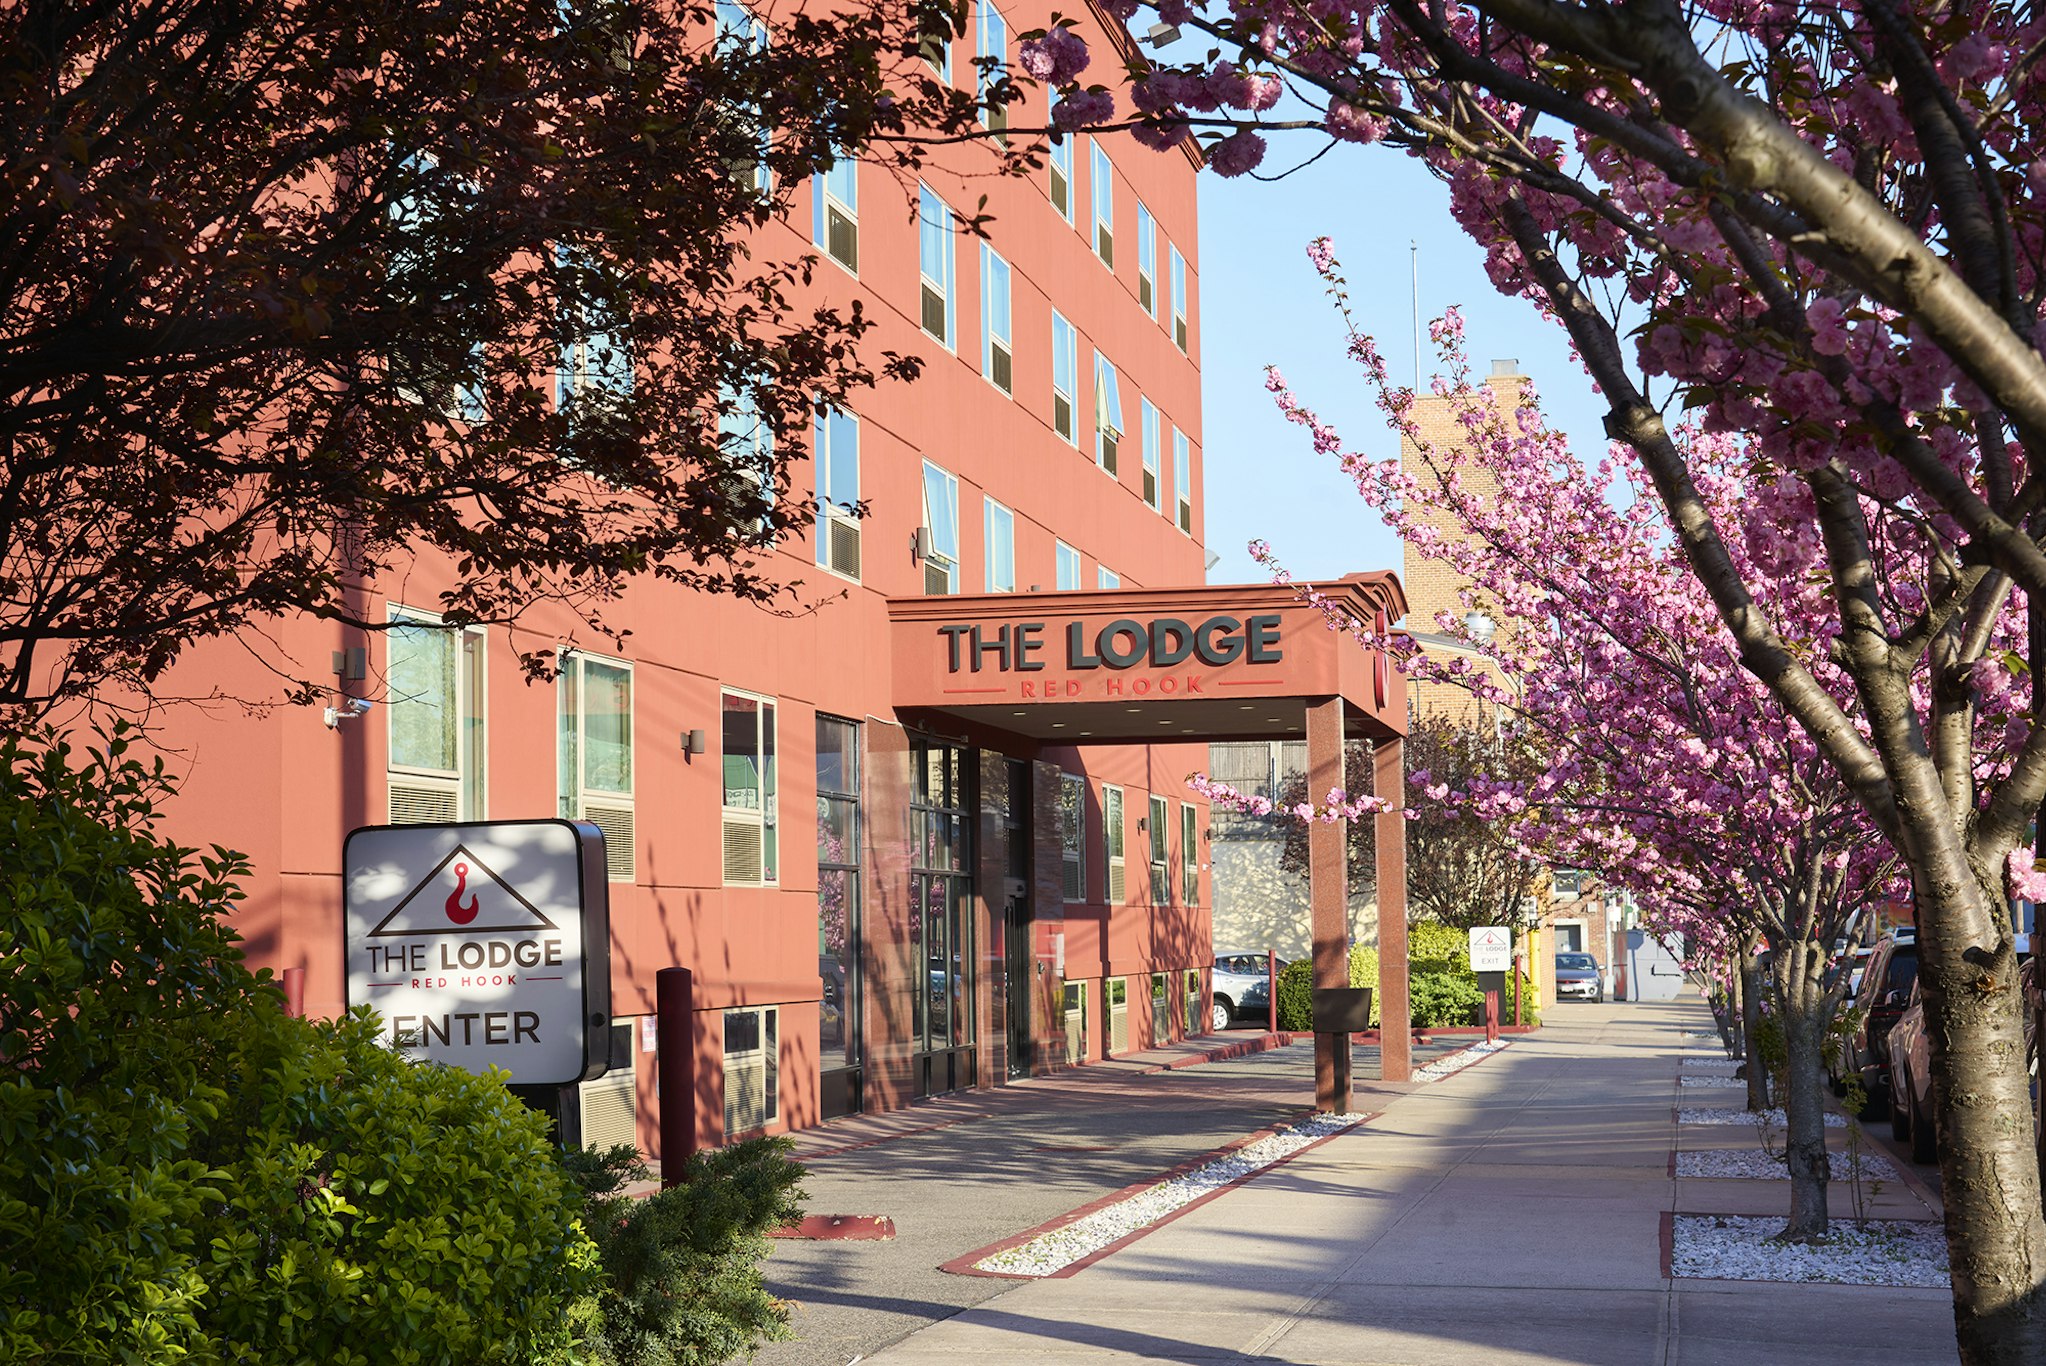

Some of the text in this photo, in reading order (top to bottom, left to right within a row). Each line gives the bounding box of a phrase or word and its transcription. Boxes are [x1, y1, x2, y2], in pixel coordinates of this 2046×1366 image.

[937, 615, 1283, 672] THE LODGE
[1021, 676, 1204, 698] RED HOOK
[366, 940, 562, 973] THE LODGE
[412, 975, 517, 988] RED HOOK
[393, 1011, 540, 1048] ENTER
